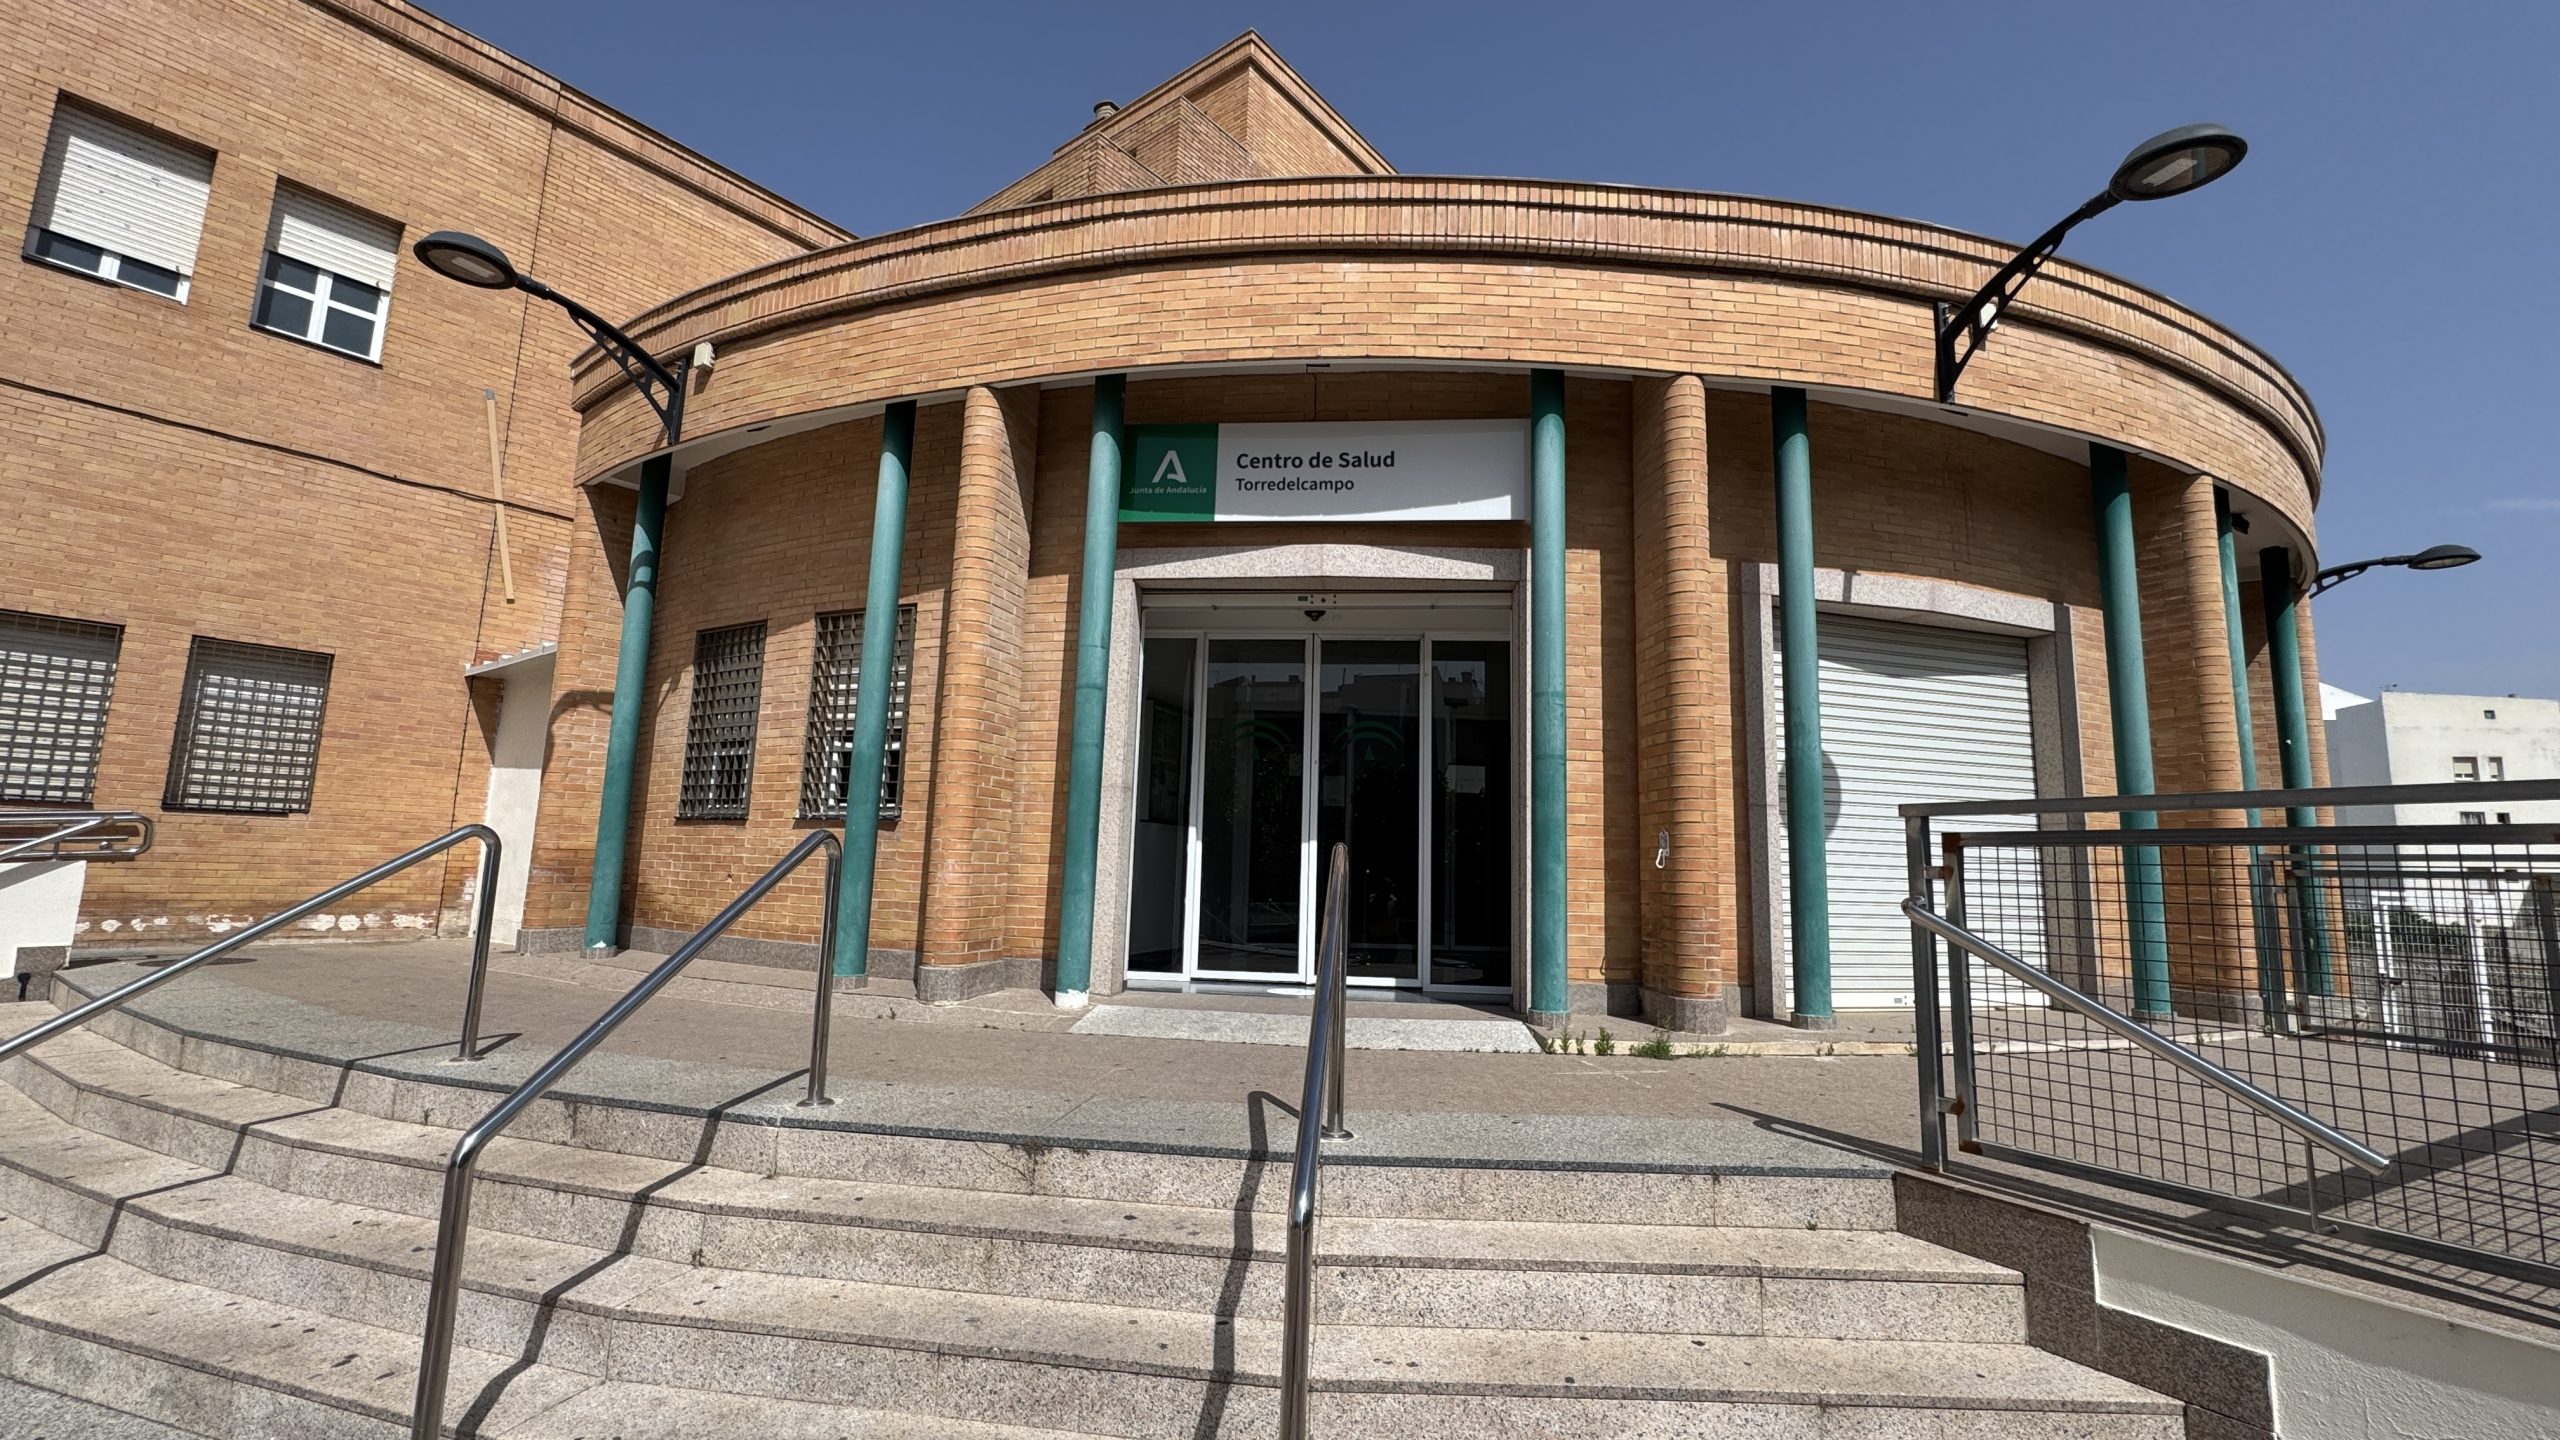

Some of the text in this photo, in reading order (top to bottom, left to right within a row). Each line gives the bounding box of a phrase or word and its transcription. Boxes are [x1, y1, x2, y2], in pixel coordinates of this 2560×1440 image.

[1236, 450, 1395, 469] Centro de Salud
[1154, 486, 1165, 494] de
[1235, 477, 1354, 494] Torredelcampo
